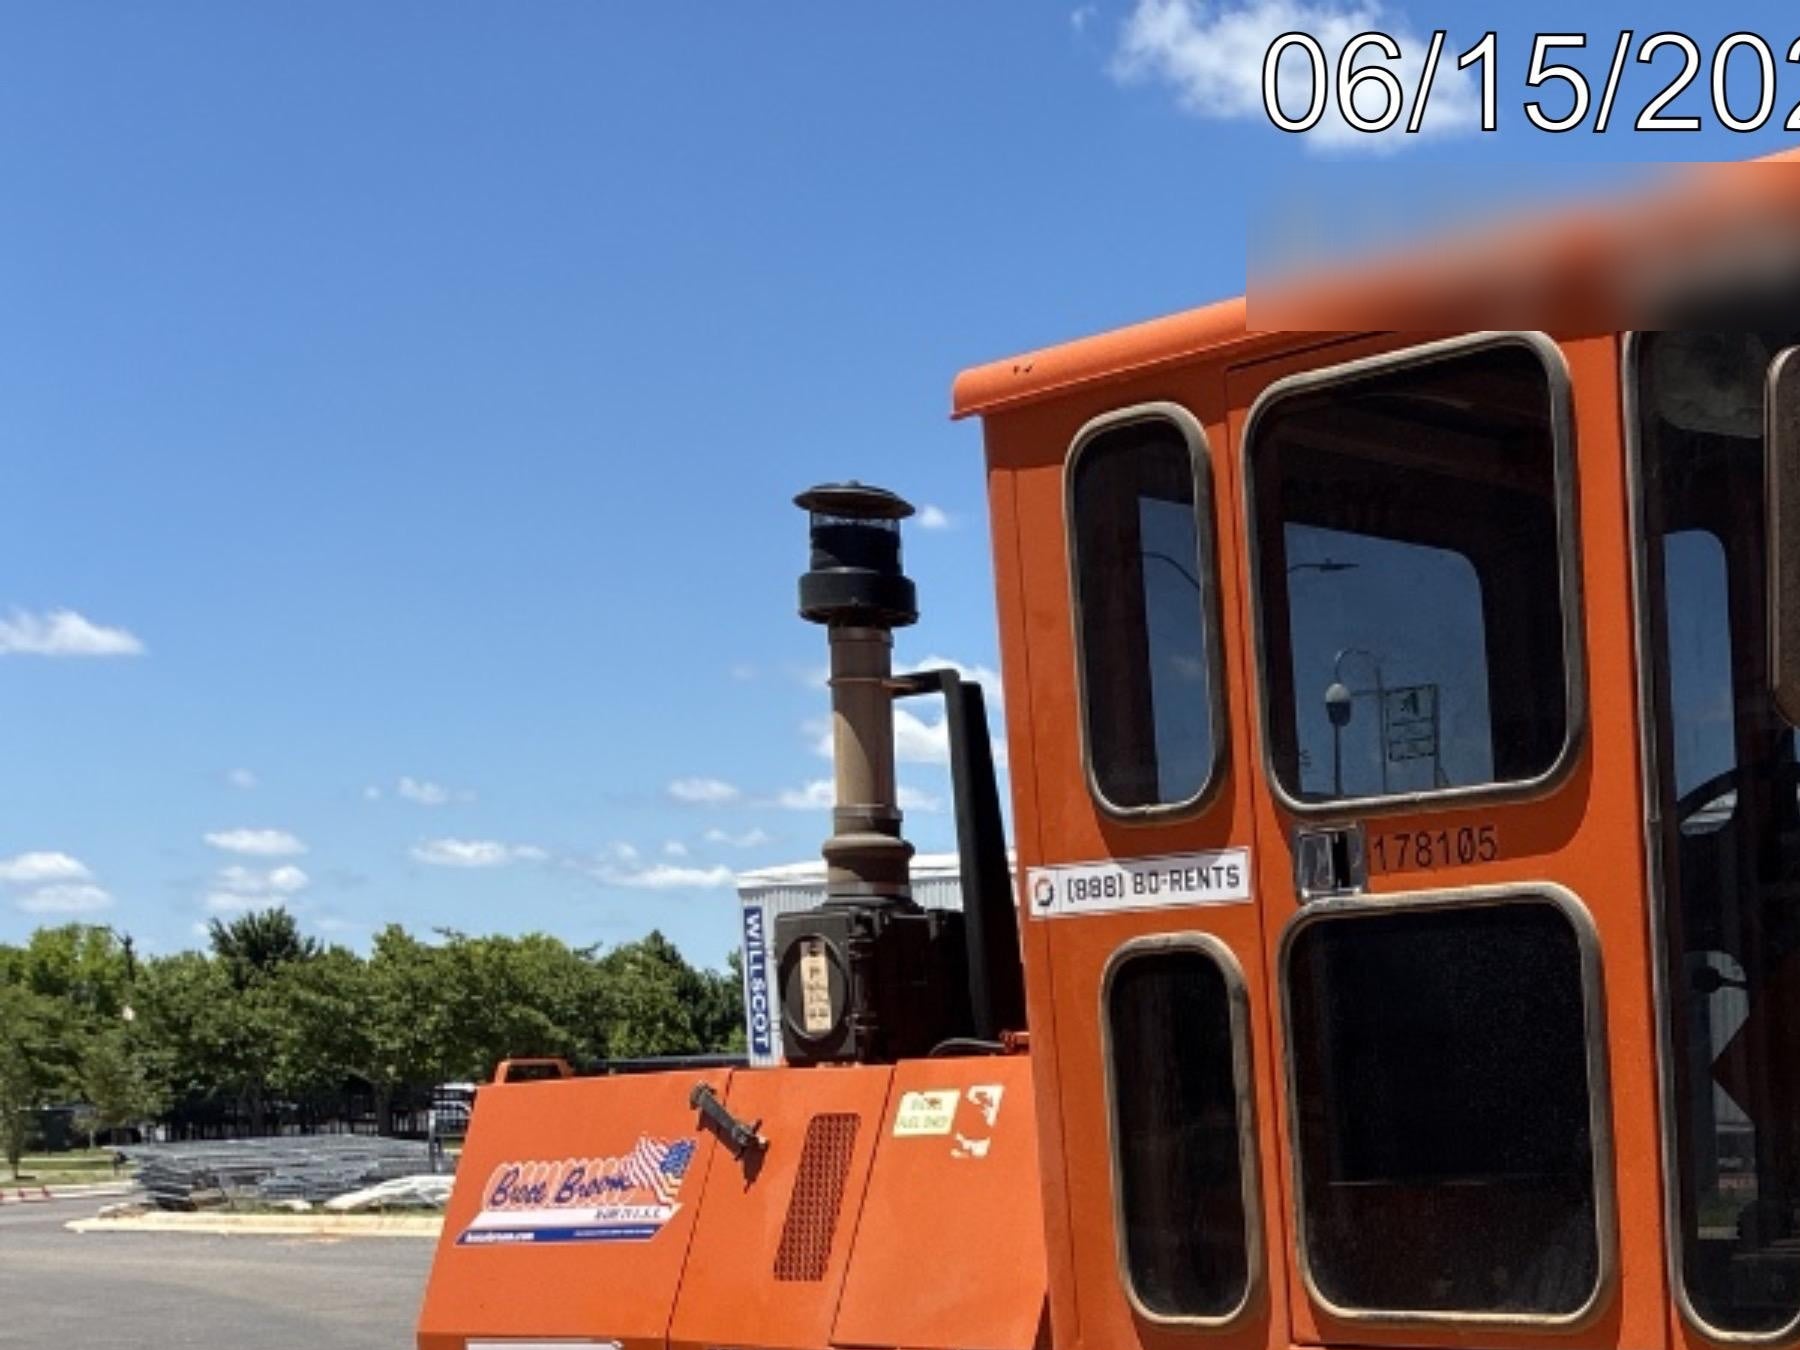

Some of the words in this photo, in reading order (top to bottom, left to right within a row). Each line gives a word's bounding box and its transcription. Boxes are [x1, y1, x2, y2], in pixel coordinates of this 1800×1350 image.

[1371, 824, 1498, 872] 178105
[1067, 873, 1124, 902] (888)
[1133, 864, 1240, 894] 80-RENTS
[746, 913, 769, 1048] WILLSCOT
